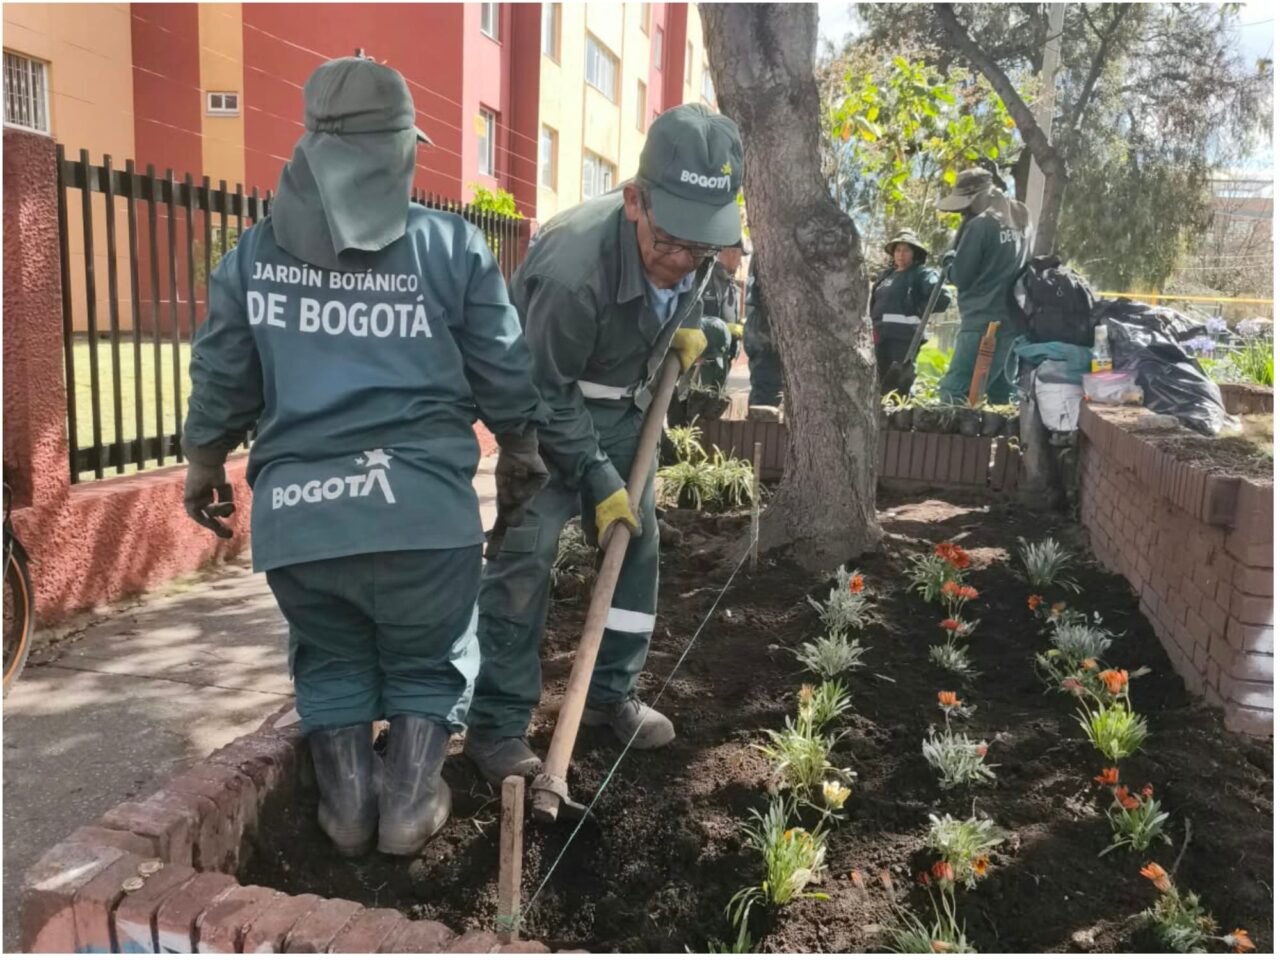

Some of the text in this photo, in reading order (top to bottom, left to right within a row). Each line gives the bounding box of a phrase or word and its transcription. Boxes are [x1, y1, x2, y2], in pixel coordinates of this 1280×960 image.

[252, 261, 418, 293] JARDÍN BOTÁNICO
[246, 290, 433, 339] DE BOGOTÁ
